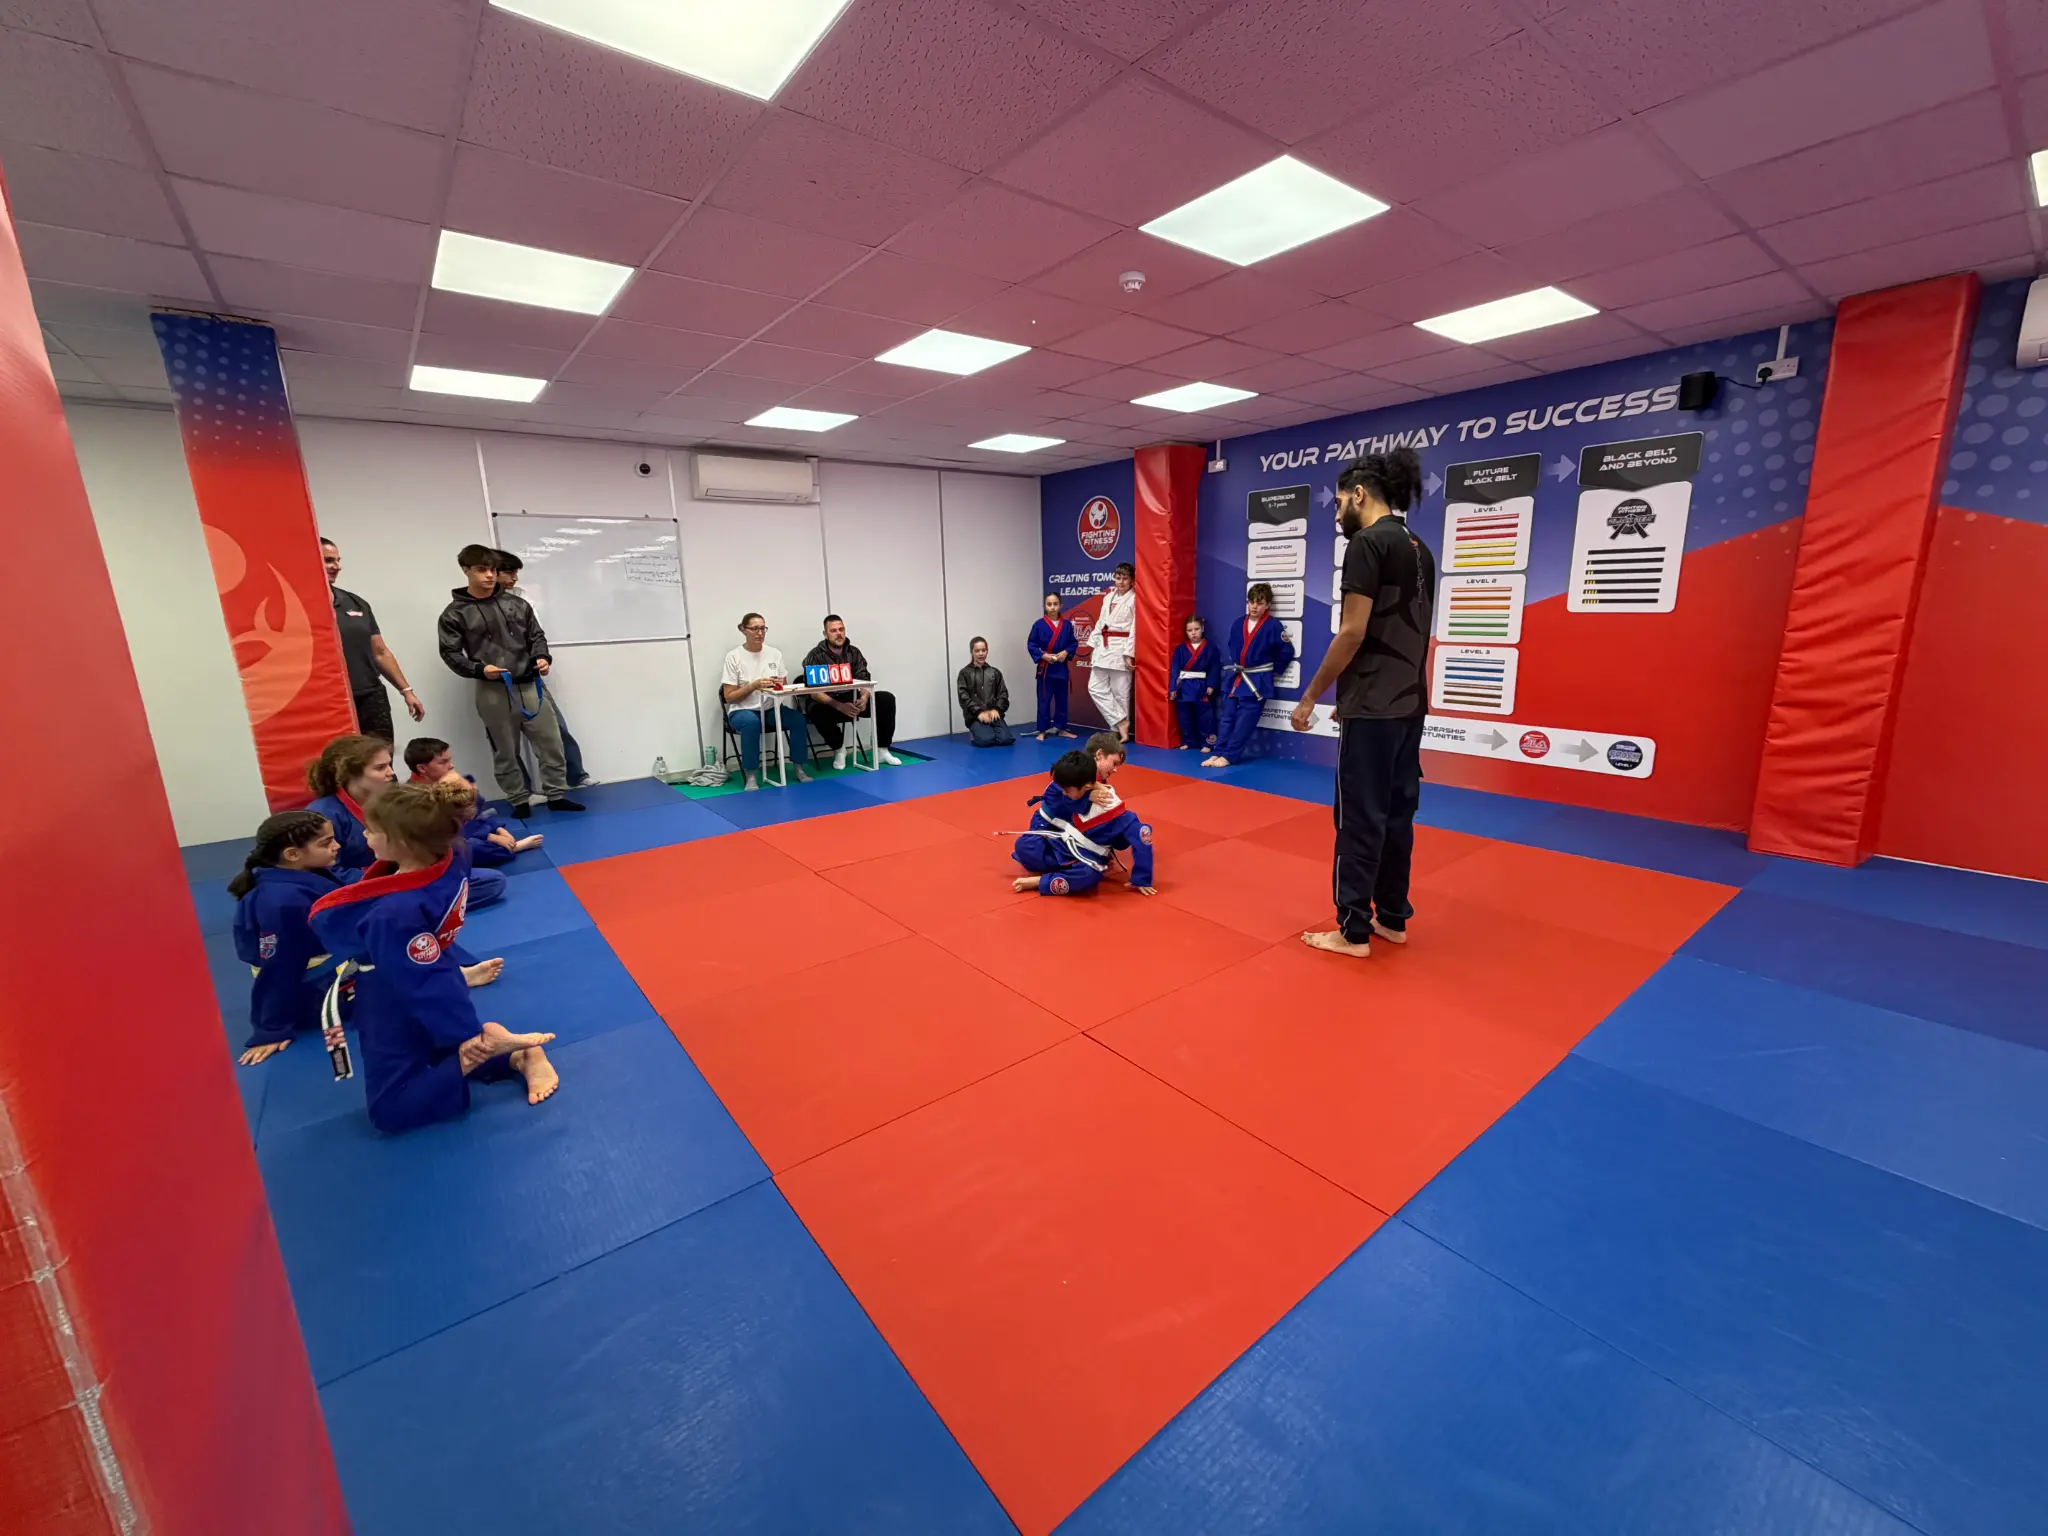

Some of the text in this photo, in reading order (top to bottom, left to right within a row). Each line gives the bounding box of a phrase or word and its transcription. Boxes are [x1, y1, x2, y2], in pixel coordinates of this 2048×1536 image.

[1259, 384, 1682, 473] YOUR PATHWAY TO SUCCESS
[1602, 447, 1676, 463] BLACK BELT
[1599, 456, 1678, 472] AND BEYOND
[1472, 466, 1510, 477] FUTURE
[1463, 473, 1518, 486] BLACK BELT
[1473, 506, 1498, 514] LEVEL
[1081, 529, 1116, 540] FIGHTING
[1083, 537, 1114, 546] FITNESS
[1048, 573, 1090, 584] CREATING
[1422, 725, 1467, 735] ADERSHIP
